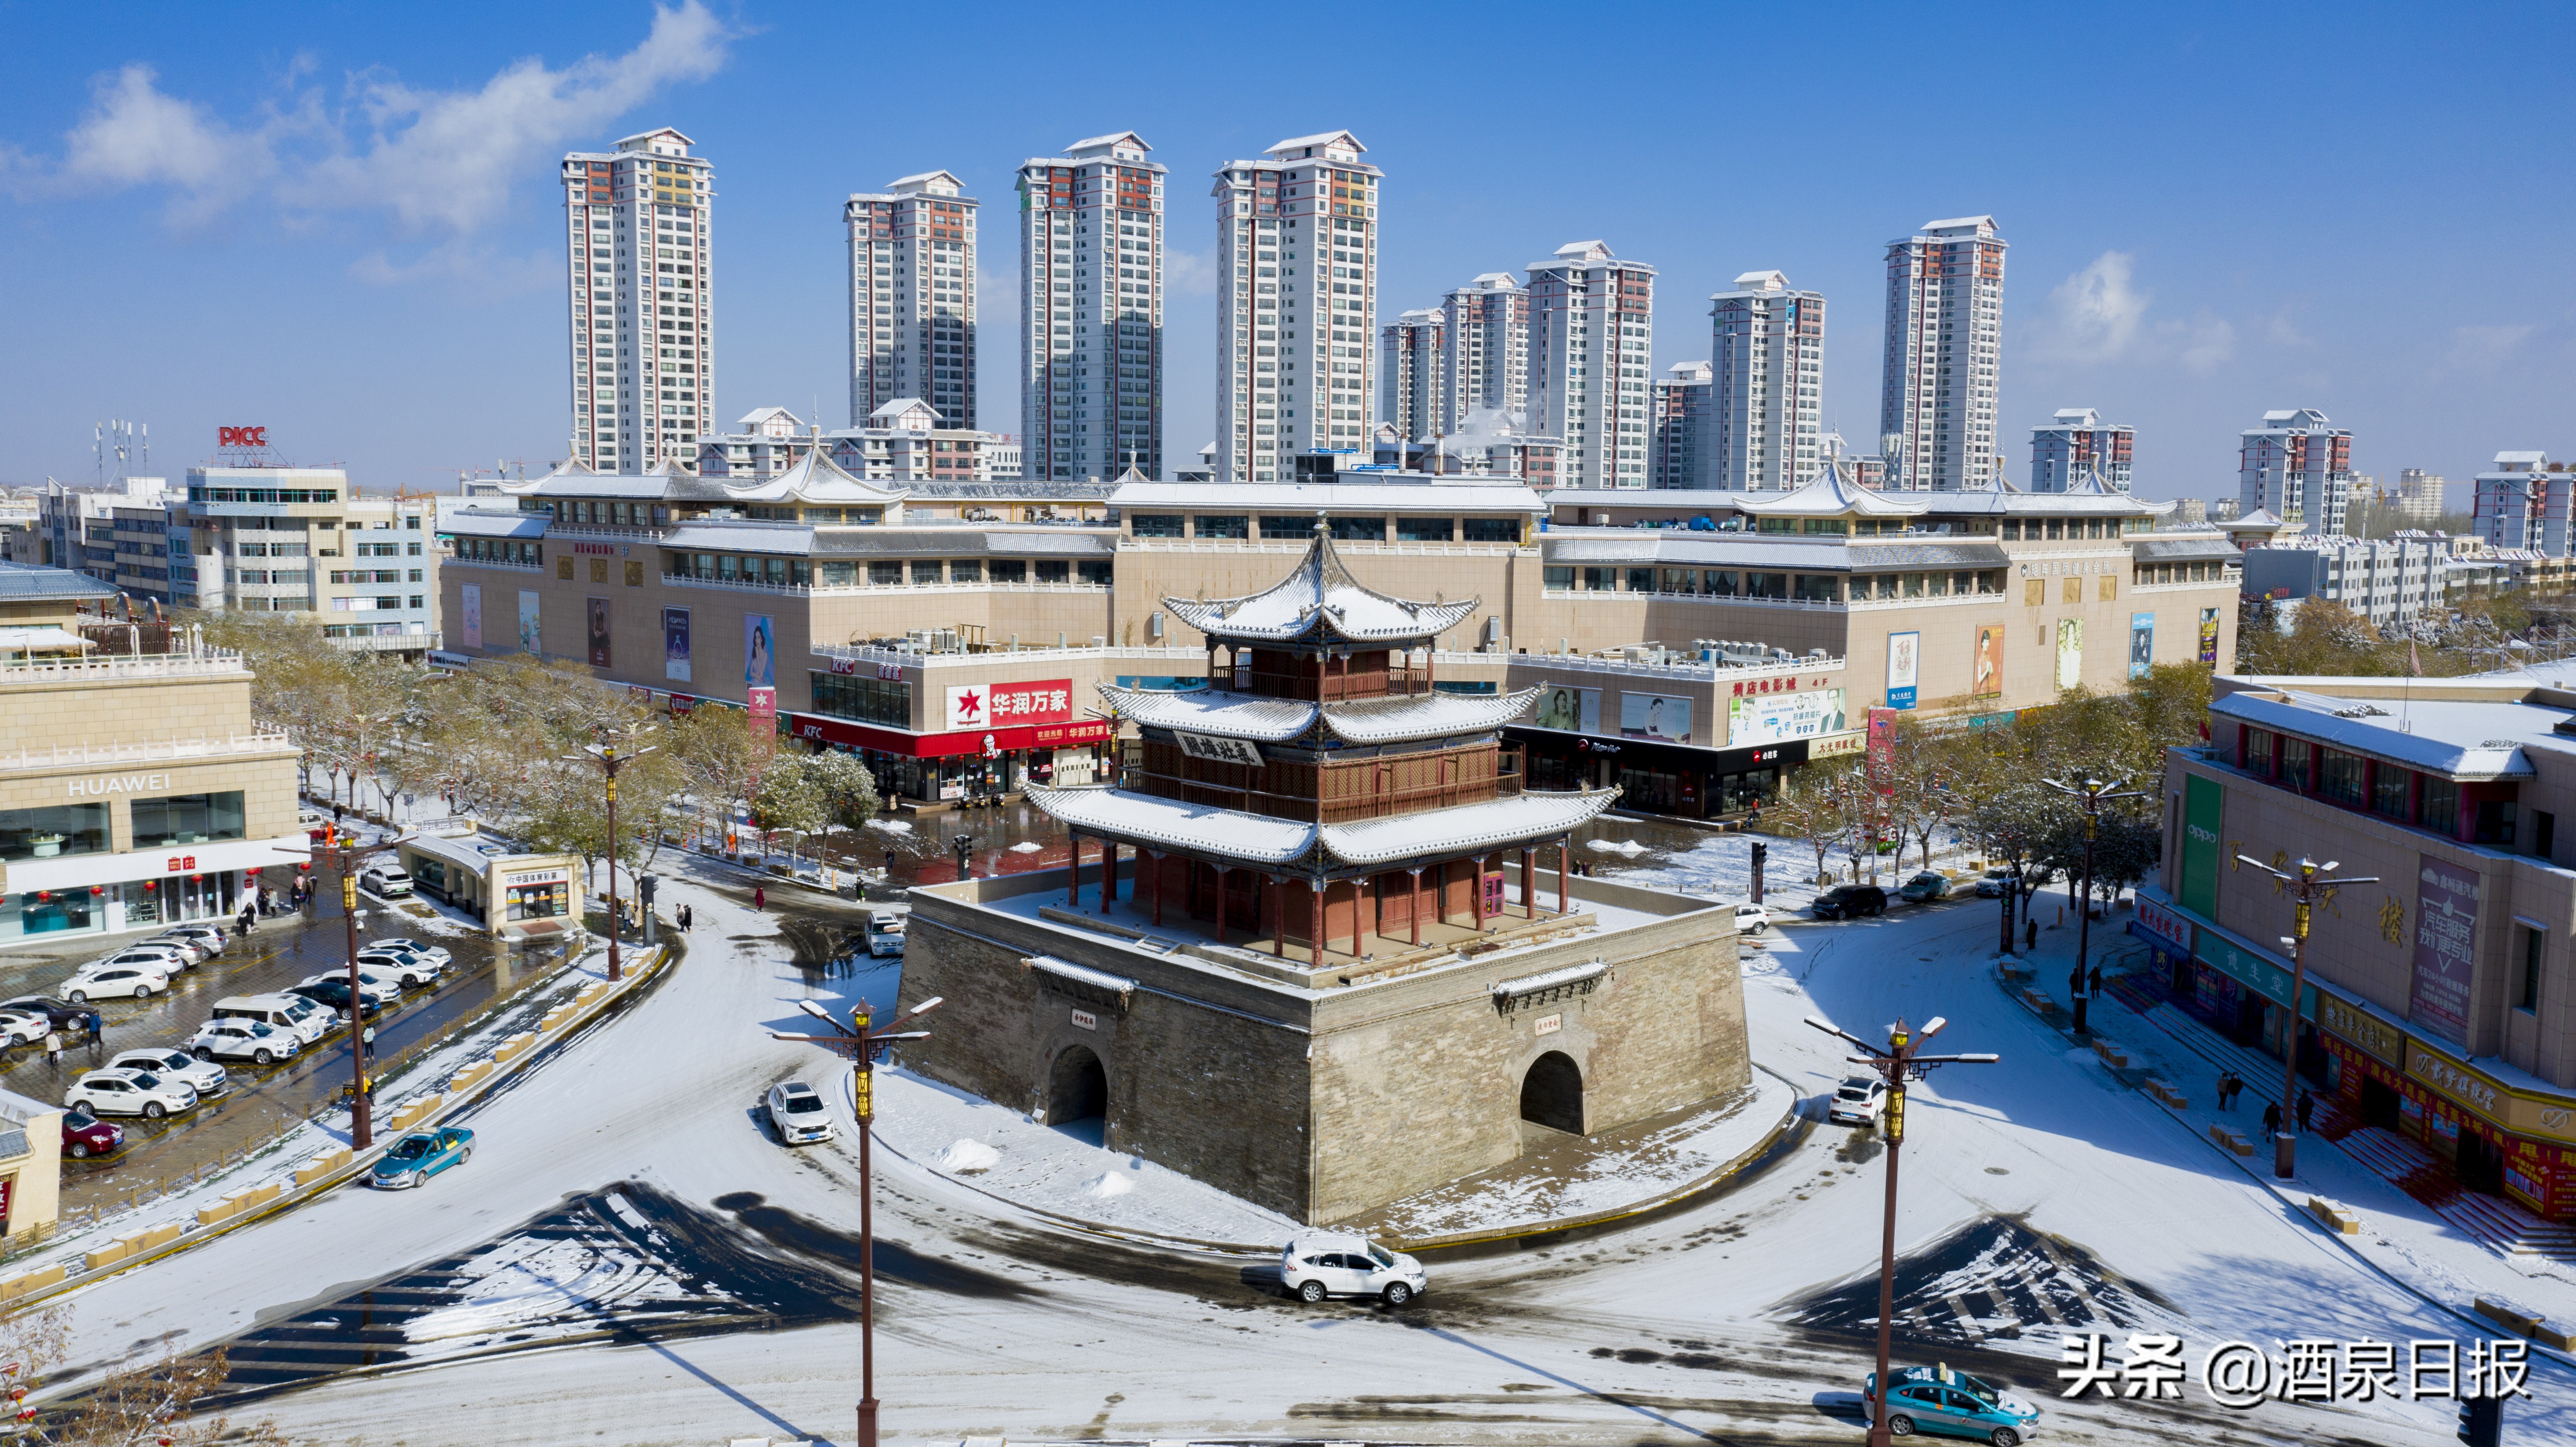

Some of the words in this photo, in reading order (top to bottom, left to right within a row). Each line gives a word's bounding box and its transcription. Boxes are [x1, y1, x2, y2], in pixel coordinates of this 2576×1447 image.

[219, 427, 266, 446] PICC
[2030, 560, 2110, 577] 矩阵国际健身会所
[831, 659, 853, 674] KFC
[878, 664, 900, 680] 肯德基
[1733, 676, 1797, 697] 横店电影城
[991, 690, 1067, 716] 华润万家
[1793, 710, 1821, 721] 抗疲劳镜片
[803, 724, 822, 739] KFC
[1037, 729, 1063, 738] 欢迎光临
[1069, 725, 1104, 738] 华润万家
[1591, 741, 1607, 751] Pizza
[1818, 738, 1857, 753] 大光明眼镜
[1763, 750, 1778, 760] 必胜客
[68, 773, 170, 797] HUAWEI
[516, 872, 557, 883] 中国体育彩票
[2439, 874, 2479, 901] 鑫畅通汽修
[2424, 909, 2470, 944] 汽车服务
[2419, 927, 2473, 965] 我们更专业
[2227, 950, 2284, 996] 德生堂
[2417, 964, 2470, 998] 汽车24小时救援服务
